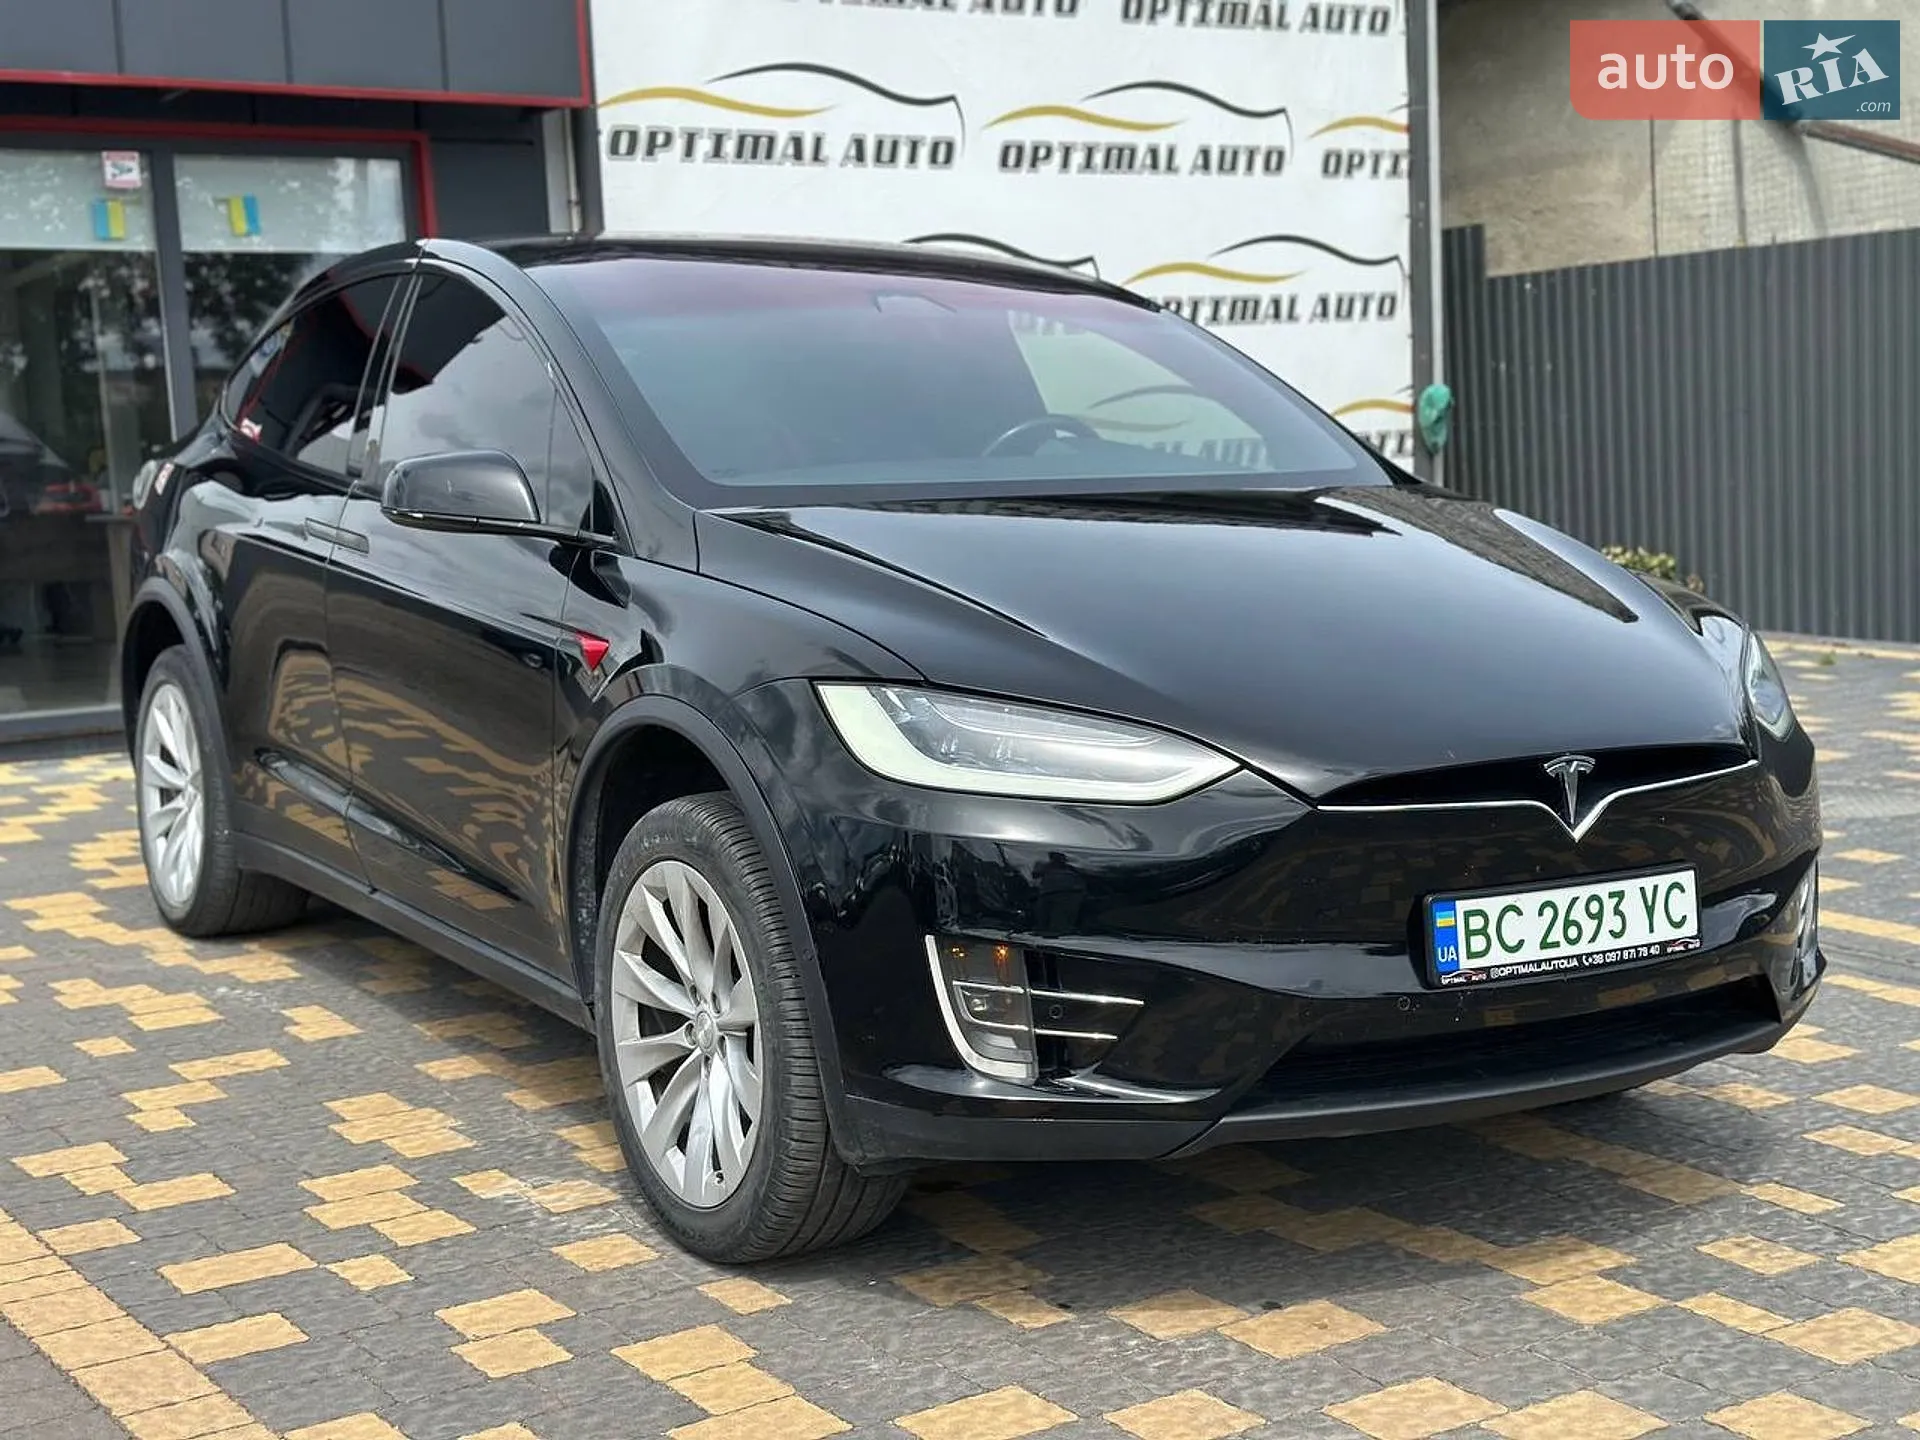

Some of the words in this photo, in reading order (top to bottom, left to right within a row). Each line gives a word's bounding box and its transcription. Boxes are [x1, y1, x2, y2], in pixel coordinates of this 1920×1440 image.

[1121, 0, 1291, 31] OPTIMAL
[1299, 2, 1391, 36] AUTO
[607, 124, 828, 168] OPTIMAL
[840, 133, 955, 170] AUTO
[998, 140, 1180, 176] OPTIMAL
[1190, 146, 1287, 177] AUTO
[1321, 149, 1409, 180] OPTI
[1308, 291, 1399, 323] AUTO
[1463, 904, 1525, 960] BC
[1537, 889, 1627, 950] 2693
[1640, 881, 1687, 934] YC
[1438, 945, 1458, 963] UA
